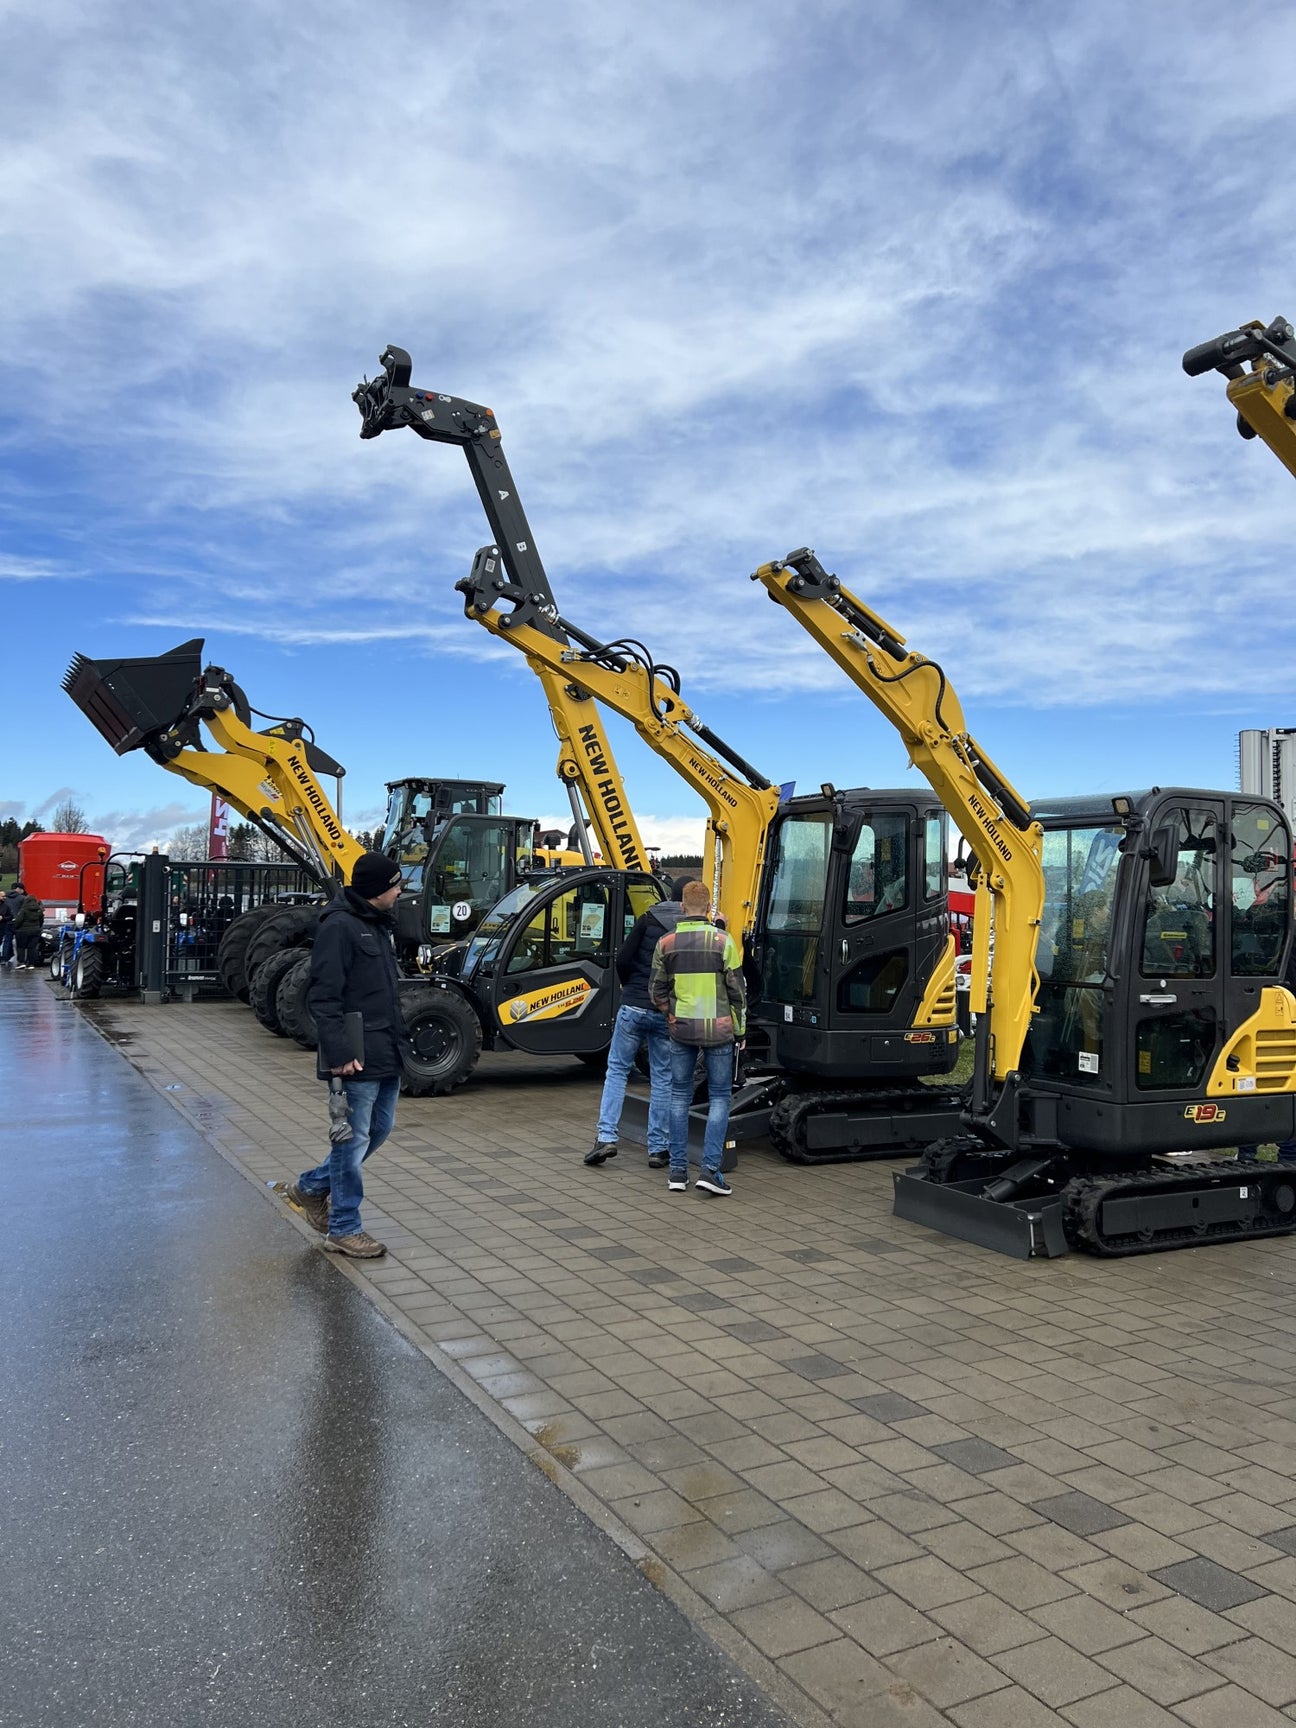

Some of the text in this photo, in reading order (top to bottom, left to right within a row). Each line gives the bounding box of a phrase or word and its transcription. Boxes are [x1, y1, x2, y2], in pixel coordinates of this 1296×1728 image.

[498, 490, 509, 500] A
[516, 541, 527, 552] B
[578, 724, 610, 776] NEW
[688, 757, 738, 808] NEW HOLLAND
[287, 755, 342, 840] NEW HOLLAND
[968, 794, 1013, 862] NEW HOLLAND
[456, 905, 468, 917] 20
[529, 996, 550, 1011] NEW
[1184, 1104, 1226, 1123] E19C
